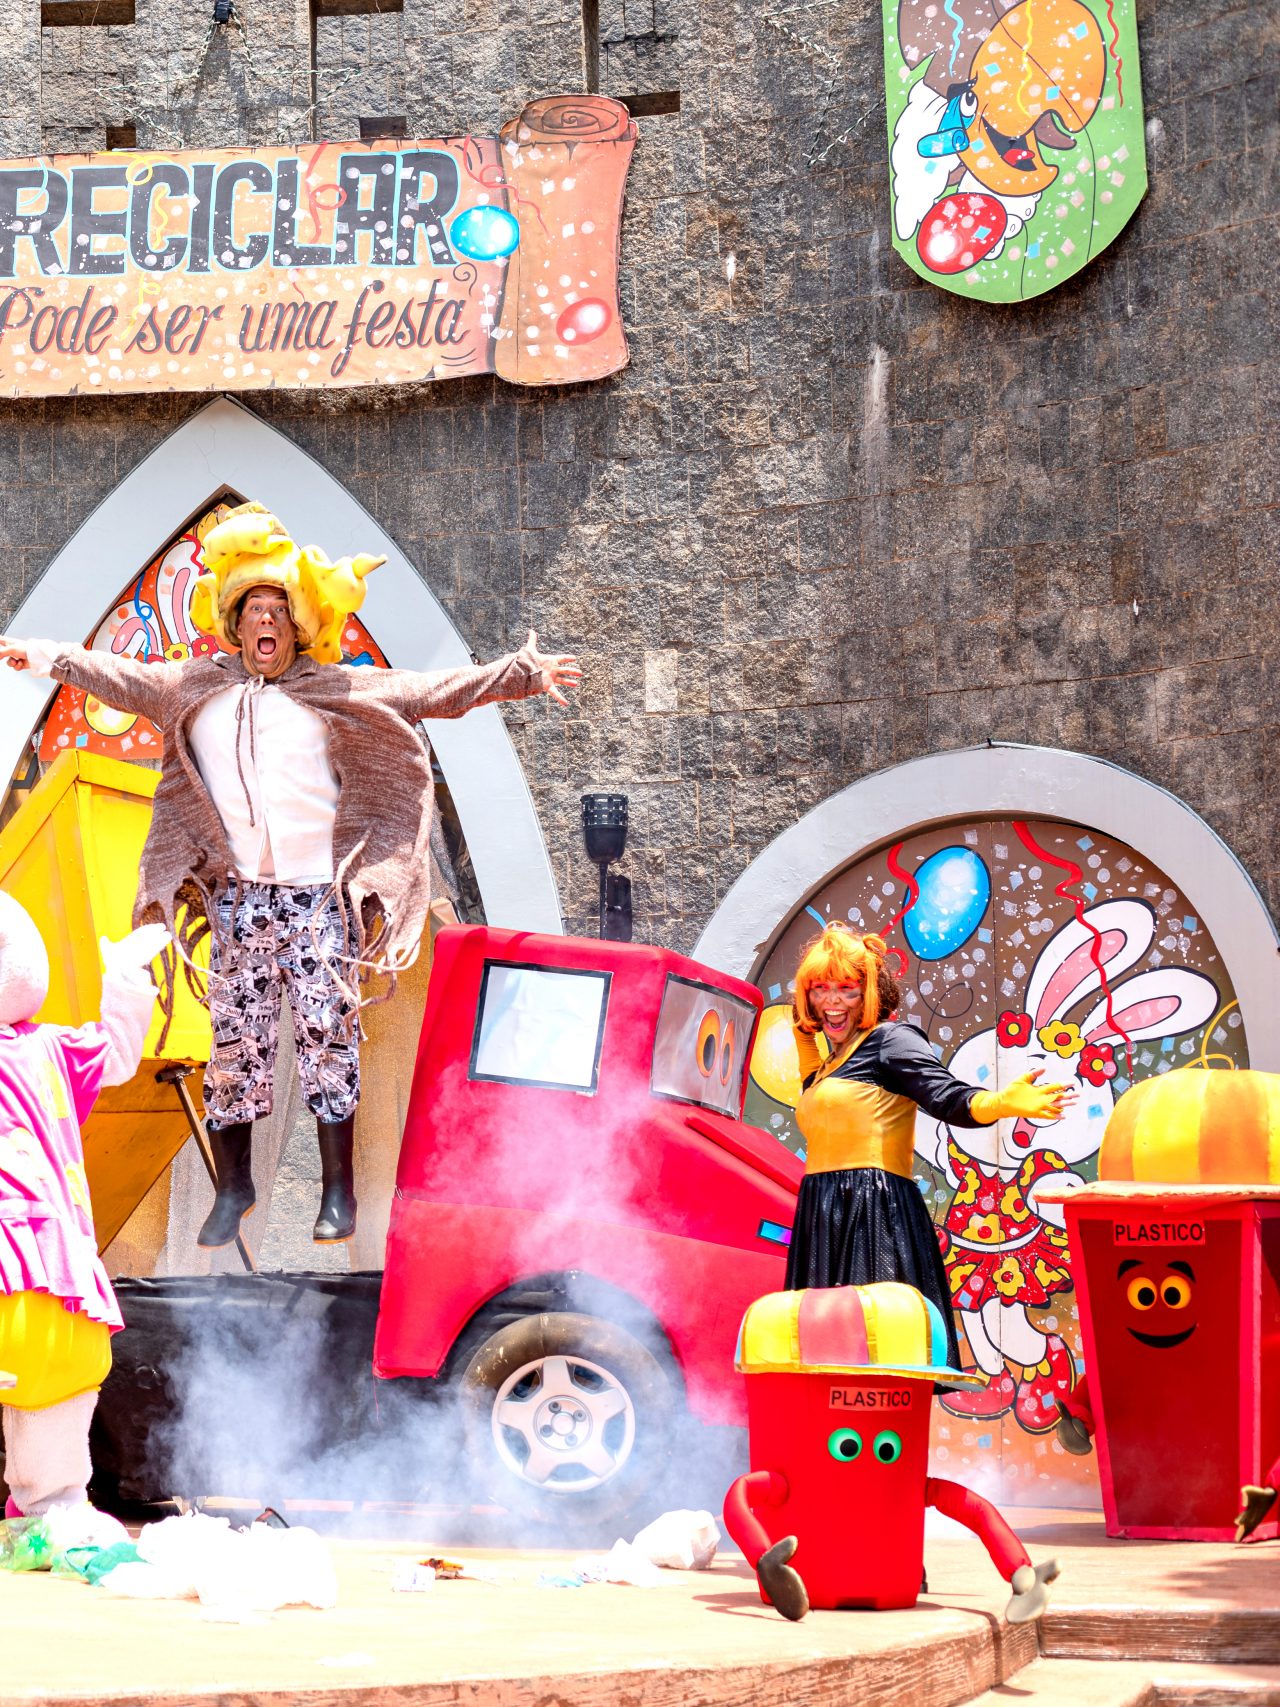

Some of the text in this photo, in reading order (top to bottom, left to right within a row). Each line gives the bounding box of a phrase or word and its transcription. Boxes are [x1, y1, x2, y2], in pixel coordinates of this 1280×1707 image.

[124, 303, 225, 355] ser
[238, 299, 339, 354] uma
[330, 278, 472, 378] festa
[1115, 1223, 1203, 1241] PLASTICO
[831, 1390, 912, 1407] PLASTICO
